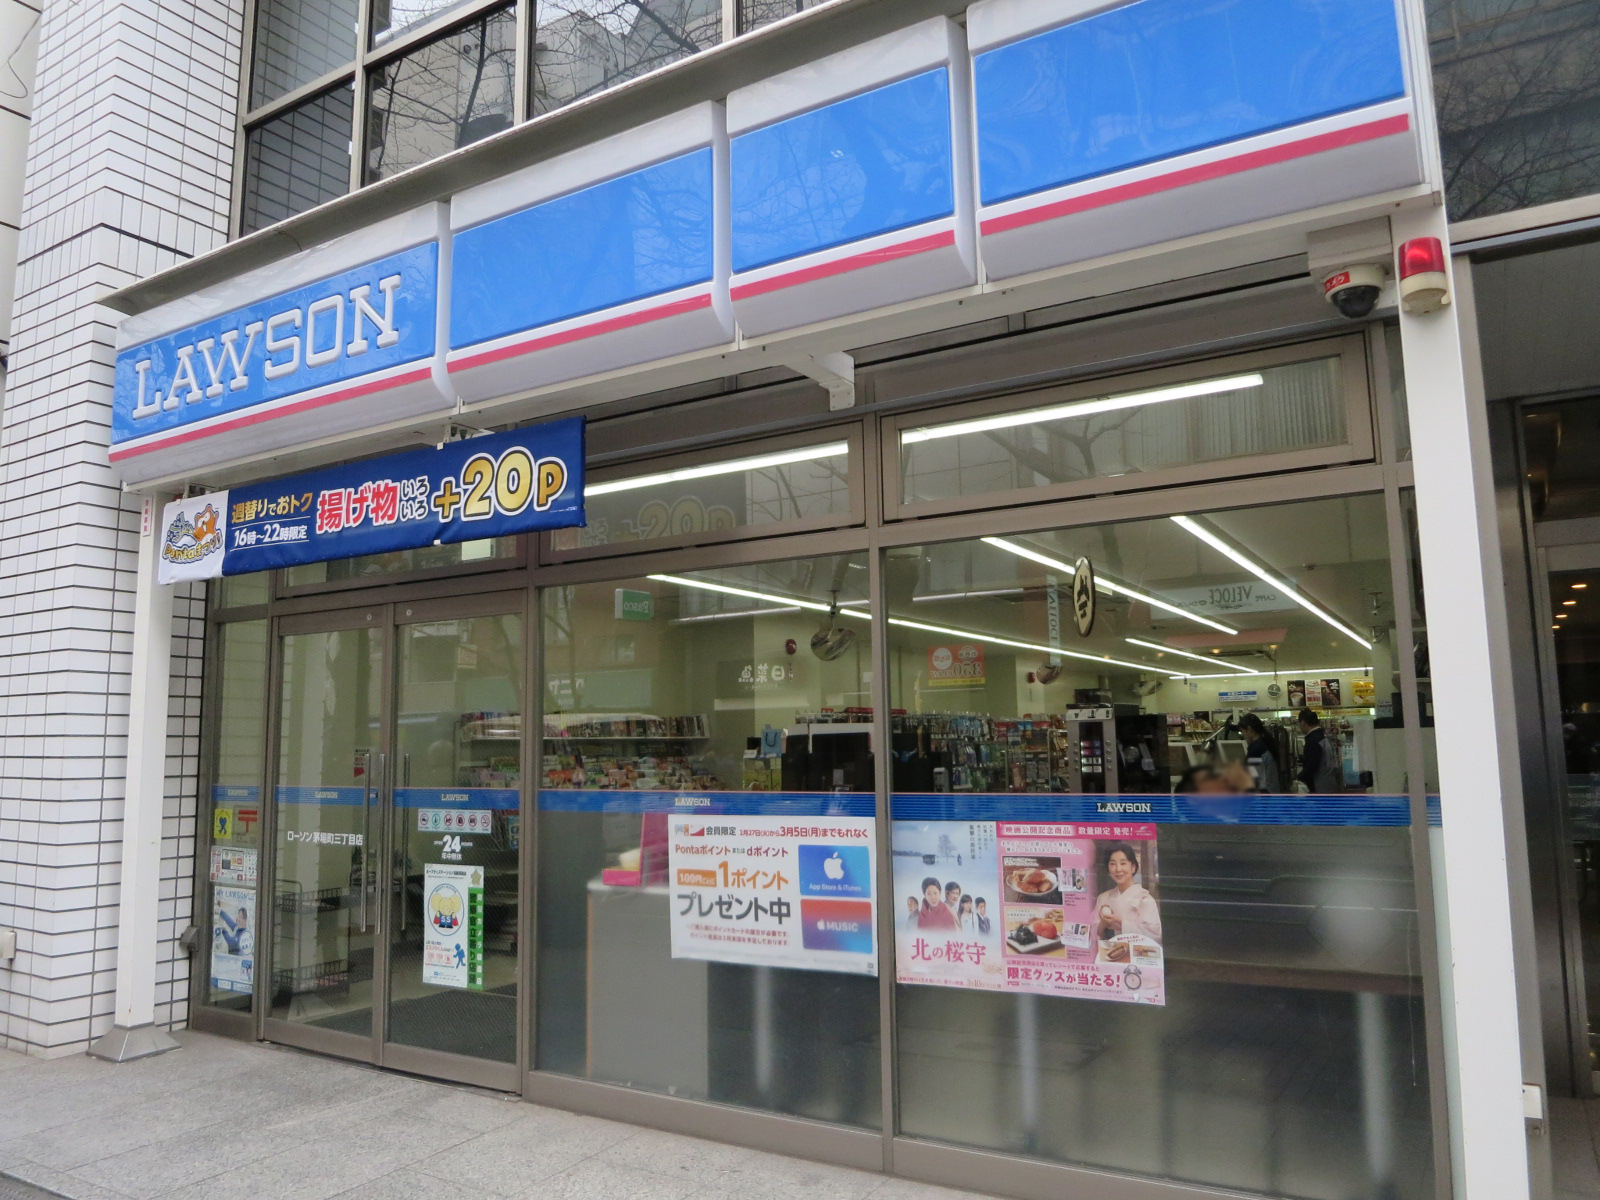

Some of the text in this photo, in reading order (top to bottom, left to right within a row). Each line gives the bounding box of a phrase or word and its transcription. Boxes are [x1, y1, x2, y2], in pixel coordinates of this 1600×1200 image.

[132, 274, 401, 420] LAWSON
[401, 475, 430, 499] いろ
[231, 492, 313, 524] 週替りでおトク
[316, 480, 401, 534] 揚げ物
[401, 498, 429, 522] いろ
[441, 793, 469, 801] LAWSON
[674, 797, 711, 807] LAWSON
[1096, 802, 1151, 813] LAWSON
[442, 834, 461, 852] 24
[706, 826, 736, 836] 会員限定
[1005, 826, 1071, 835] 映画公開記念商品
[1078, 827, 1111, 836] 数量限定
[718, 860, 789, 891] 1ポイント
[677, 891, 791, 925] プレゼント中
[826, 921, 859, 932] MUSIC
[911, 938, 987, 965] 北の桜守
